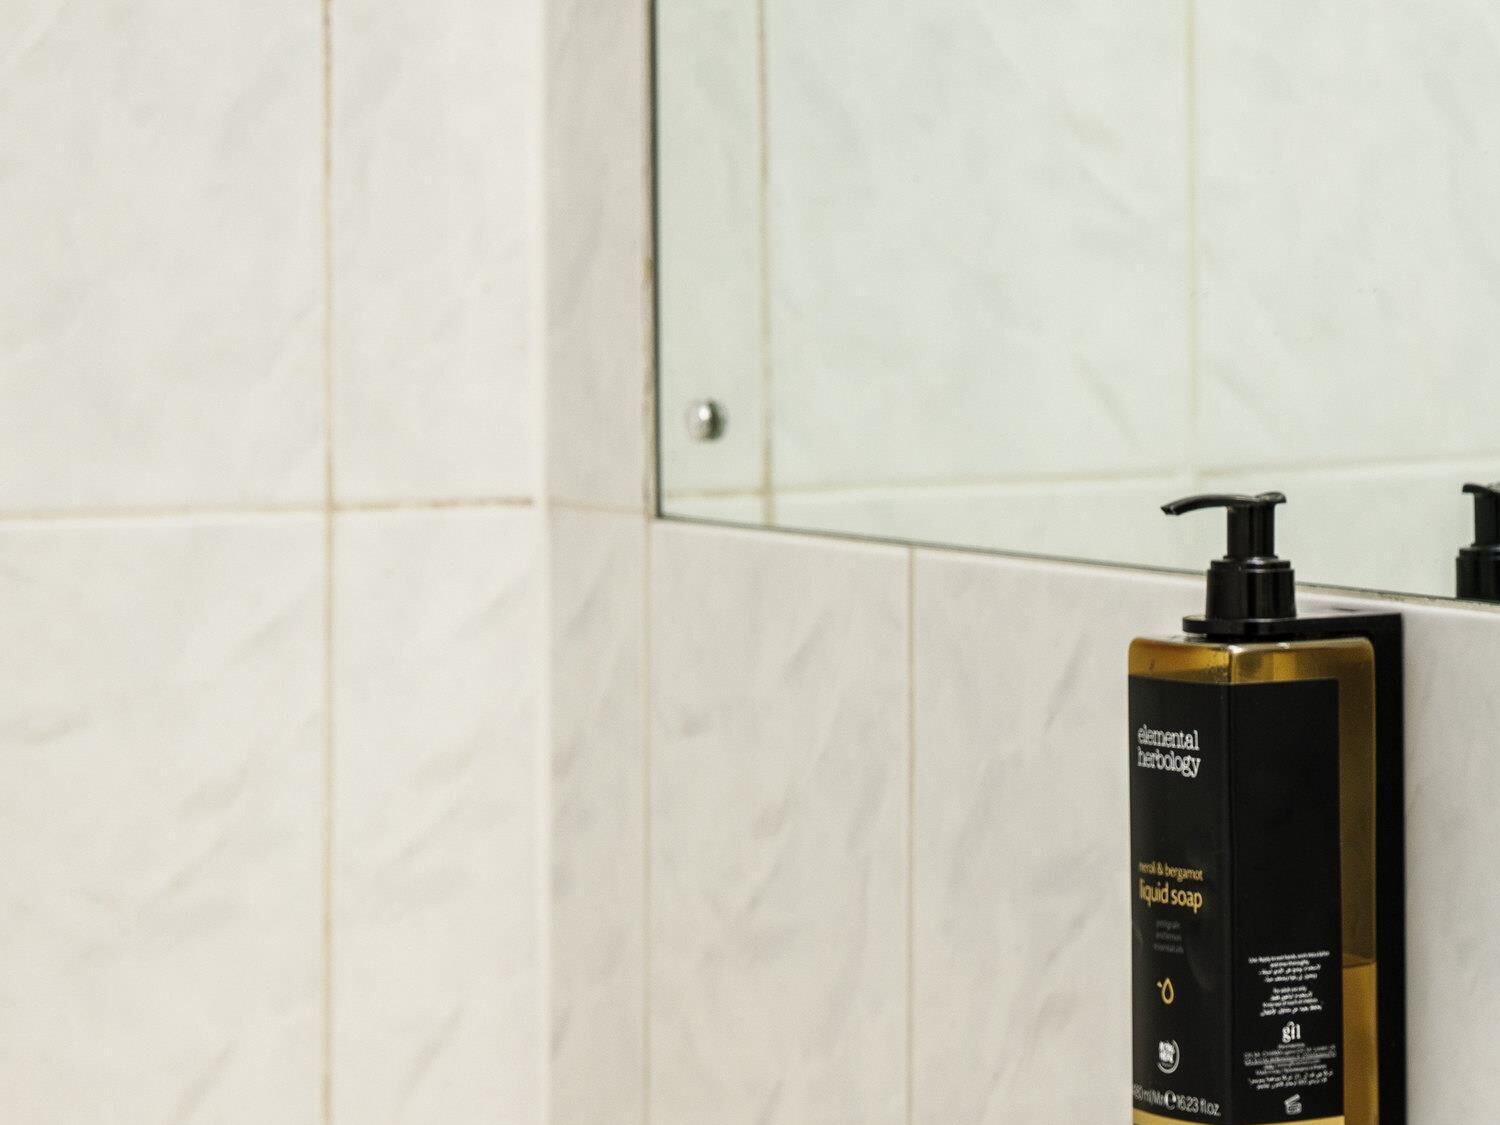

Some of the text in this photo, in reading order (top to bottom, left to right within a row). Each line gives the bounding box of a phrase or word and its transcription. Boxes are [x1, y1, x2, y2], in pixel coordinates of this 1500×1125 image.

[1138, 724, 1200, 751] elemental
[1137, 745, 1201, 778] herbology
[1165, 863, 1204, 883] bergamot
[1139, 878, 1203, 914] liquid soap
